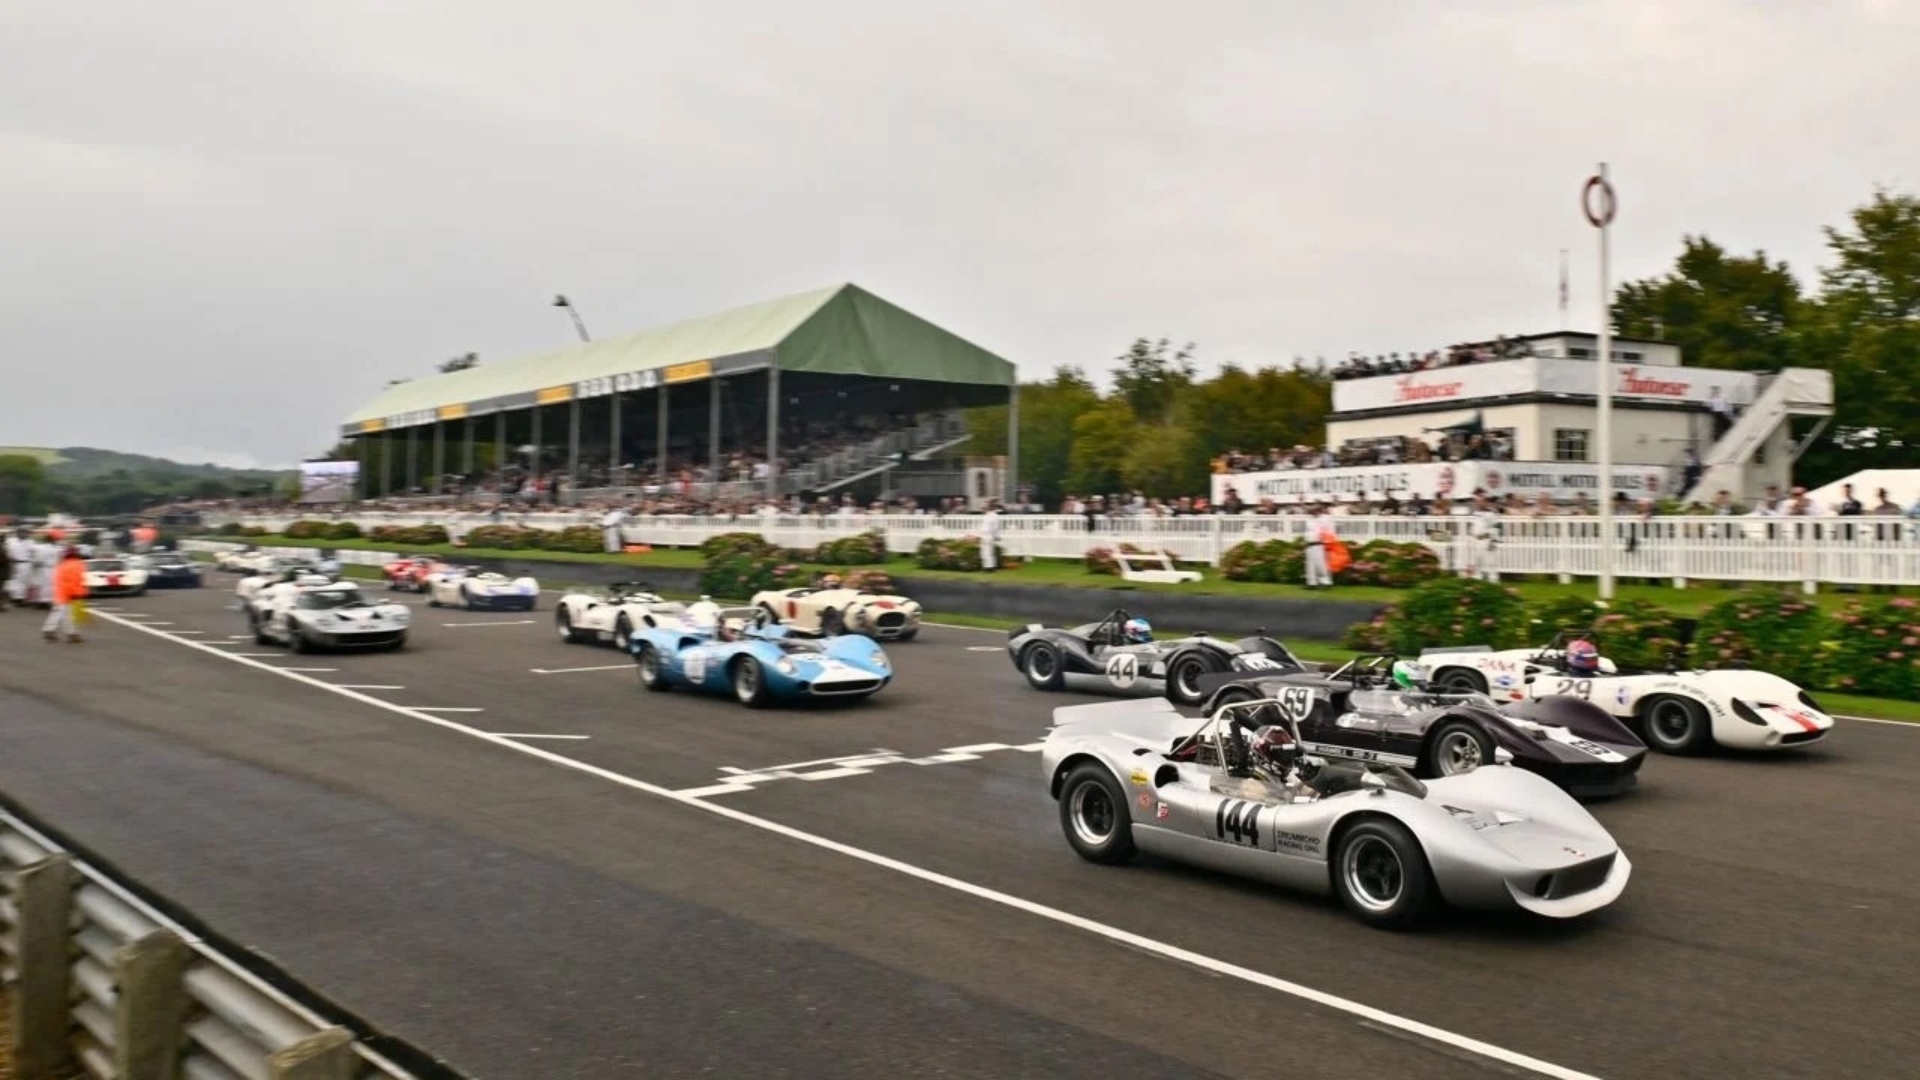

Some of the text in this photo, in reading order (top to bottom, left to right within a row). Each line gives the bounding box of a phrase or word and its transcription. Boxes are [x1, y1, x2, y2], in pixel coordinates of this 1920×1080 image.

[1255, 473, 1408, 495] MOTUL MOTOR OILS
[1509, 473, 1556, 488] MOTUL
[1109, 658, 1135, 681] 44
[1556, 679, 1592, 700] 29
[1284, 687, 1308, 718] 69
[1216, 798, 1263, 846] 144
